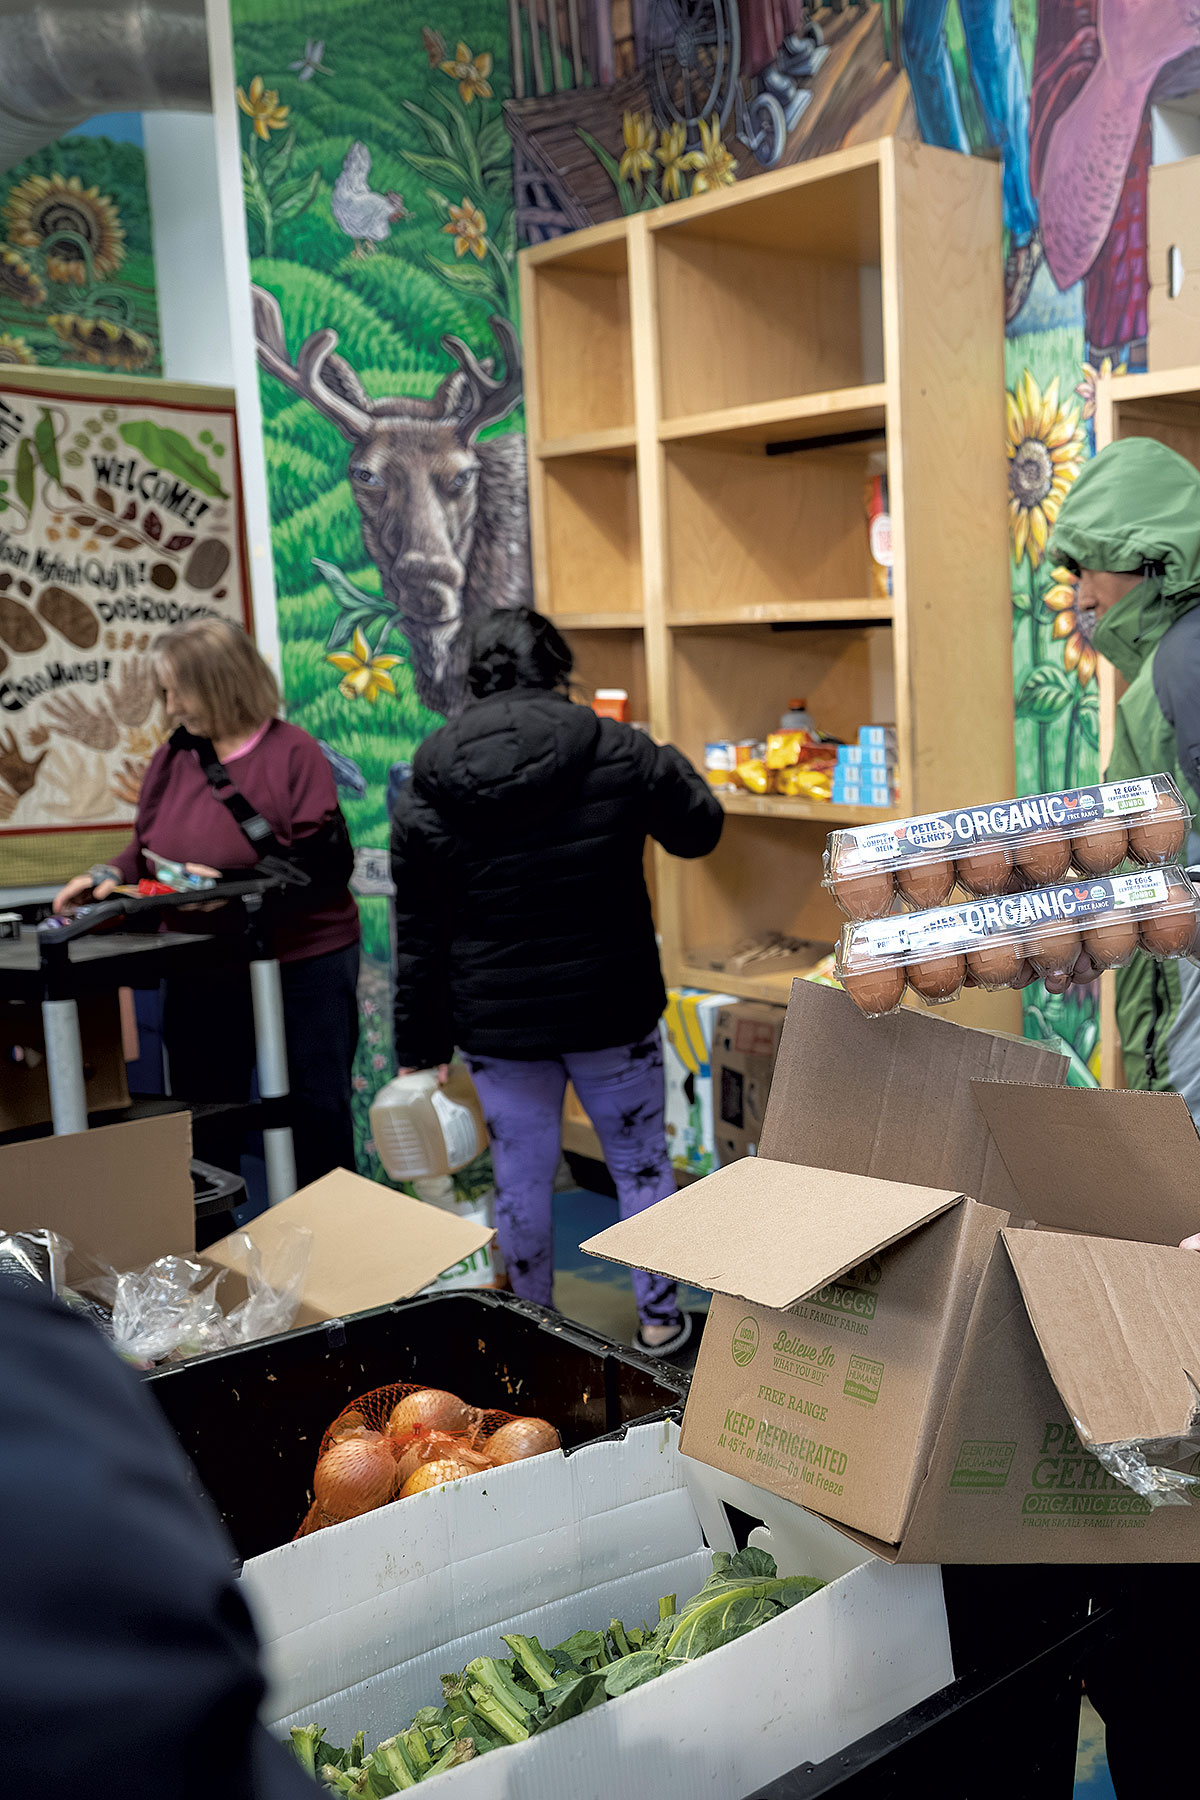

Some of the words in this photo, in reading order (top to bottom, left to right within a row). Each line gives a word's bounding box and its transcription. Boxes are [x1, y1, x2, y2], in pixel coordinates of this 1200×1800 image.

[1113, 787, 1121, 795] 12
[1123, 784, 1142, 794] EGGS
[1119, 798, 1143, 809] JUMBO
[955, 796, 1066, 839] ORGANIC
[1067, 812, 1080, 821] FREE
[1080, 809, 1099, 819] RANGE
[911, 822, 936, 835] PETE
[937, 821, 945, 830] &
[1124, 879, 1133, 887] 12
[1134, 875, 1153, 885] EGGS
[966, 888, 1076, 932] ORGANIC
[1078, 904, 1091, 912] FREE
[832, 1287, 875, 1315] EGGS
[787, 1306, 809, 1319] MALL
[809, 1309, 840, 1327] FAMILY
[840, 1318, 869, 1336] FARMS
[739, 1327, 755, 1342] USDA
[772, 1330, 818, 1362] Believe
[816, 1345, 836, 1368] In
[773, 1357, 795, 1373] WHAT
[794, 1363, 811, 1378] YOU
[850, 1359, 882, 1377] CERTIFIED
[849, 1370, 880, 1387] HUMANE
[757, 1384, 787, 1407] FREE
[787, 1395, 829, 1422] RANGE
[723, 1408, 756, 1438] KEEP
[755, 1420, 848, 1476] REFRIGERATED
[962, 1446, 1013, 1457] CERTIFIED
[727, 1437, 747, 1455] 45°F
[746, 1447, 756, 1460] or
[800, 1466, 815, 1485] Not
[815, 1472, 844, 1496] Freeze
[1025, 1495, 1104, 1513] ORGANIC
[1106, 1496, 1151, 1513] EGGS
[1022, 1519, 1051, 1528] FROM
[1051, 1519, 1081, 1528] SMALL
[1082, 1519, 1115, 1529] FAMILY
[1116, 1519, 1146, 1529] FARMS
